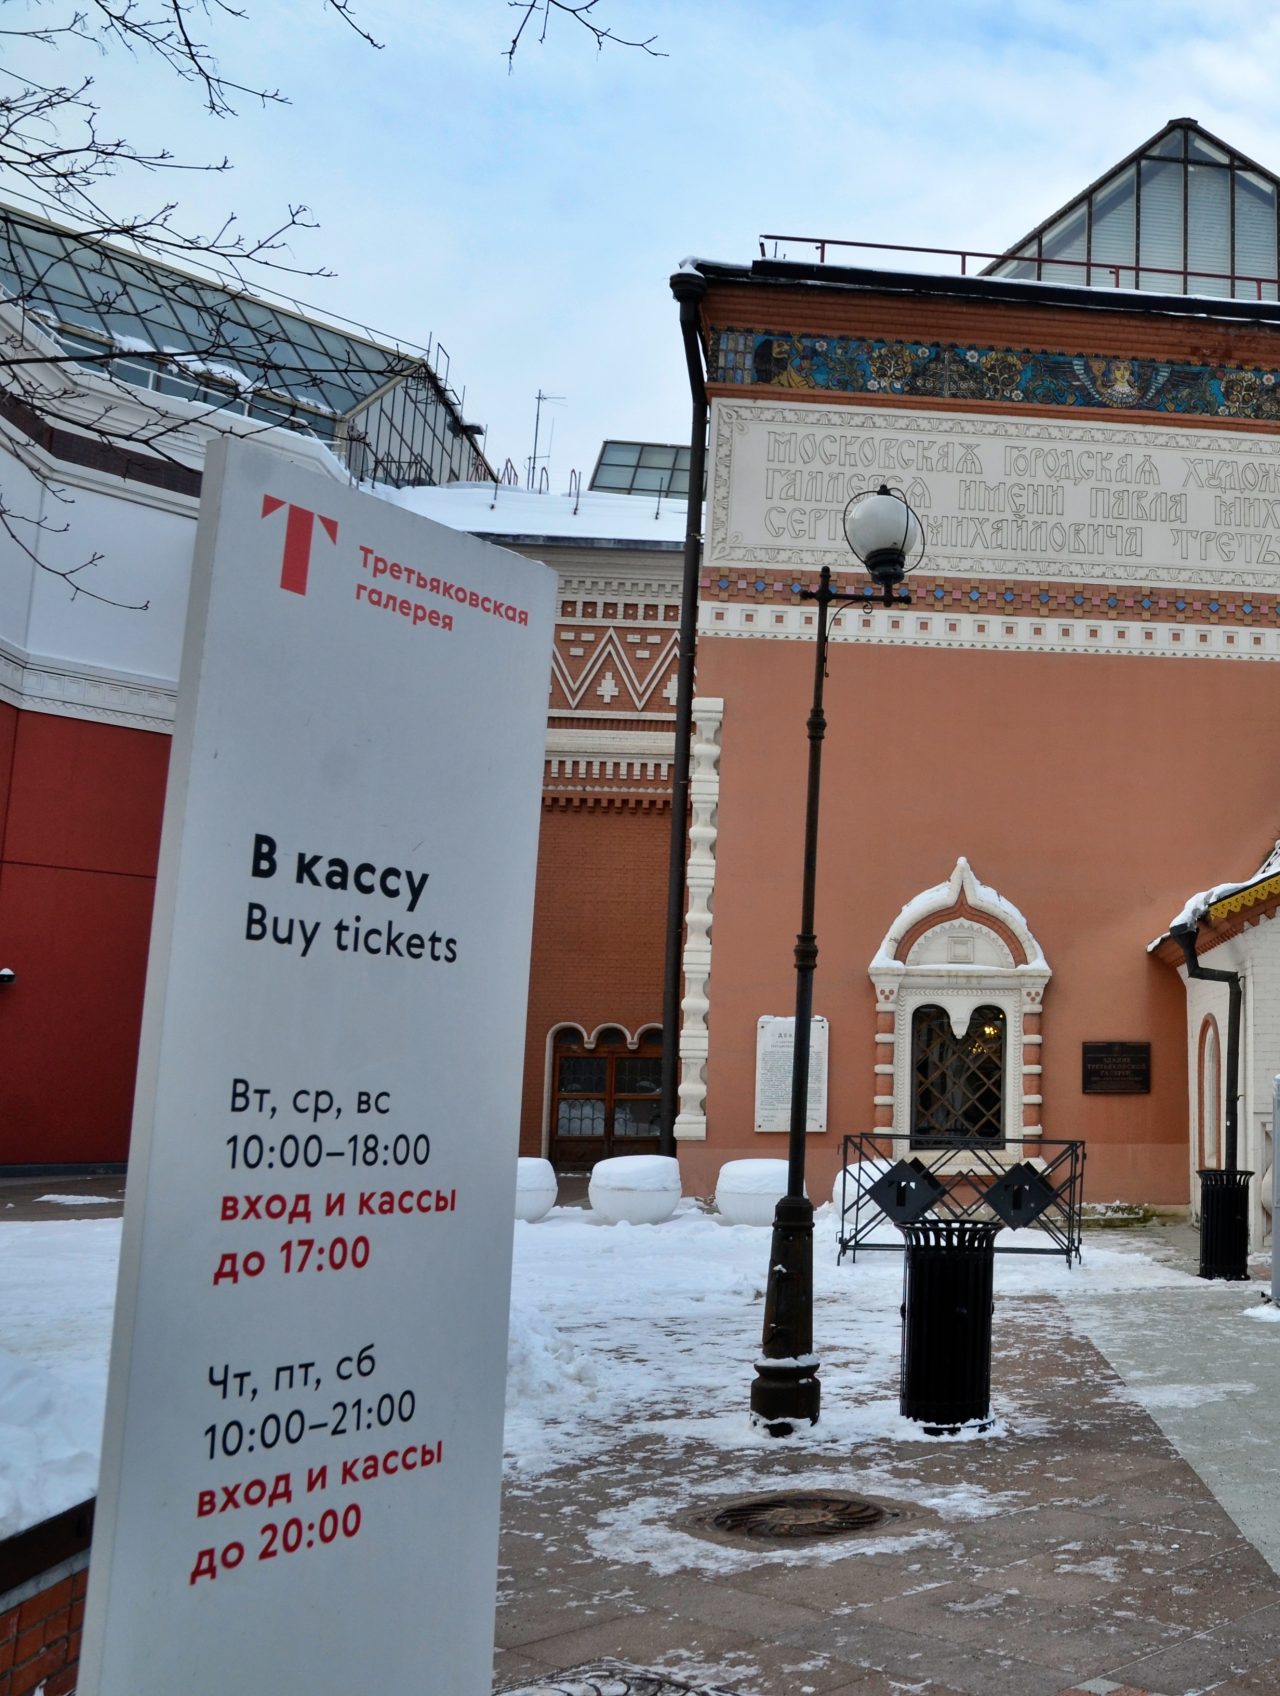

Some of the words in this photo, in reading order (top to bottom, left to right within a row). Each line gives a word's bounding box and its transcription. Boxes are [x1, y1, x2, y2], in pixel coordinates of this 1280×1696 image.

[958, 479, 1065, 516] ИМЕНИ
[1090, 487, 1187, 523] ПАВЛА
[920, 512, 1143, 557] МИХАЙЛОВИЧА
[355, 582, 455, 631] галерея
[358, 544, 530, 627] Третьяковская
[252, 833, 278, 879] В
[296, 852, 430, 912] кассу
[246, 902, 322, 958] Buy
[334, 914, 457, 963] tickets
[231, 1077, 278, 1120] Вт,
[293, 1090, 343, 1123] ср,
[357, 1091, 391, 1115] вс
[221, 1193, 312, 1225] вход
[326, 1192, 346, 1217] и
[359, 1190, 457, 1216] кассы
[213, 1251, 266, 1285] до
[281, 1236, 370, 1273] 17:00
[209, 1364, 258, 1402] Чт,
[275, 1362, 322, 1392] пт,
[336, 1344, 376, 1381] сб
[197, 1474, 293, 1517] вход
[307, 1465, 328, 1492] и
[342, 1441, 443, 1484] кассы
[190, 1542, 245, 1586] до
[258, 1504, 362, 1561] 20:00
